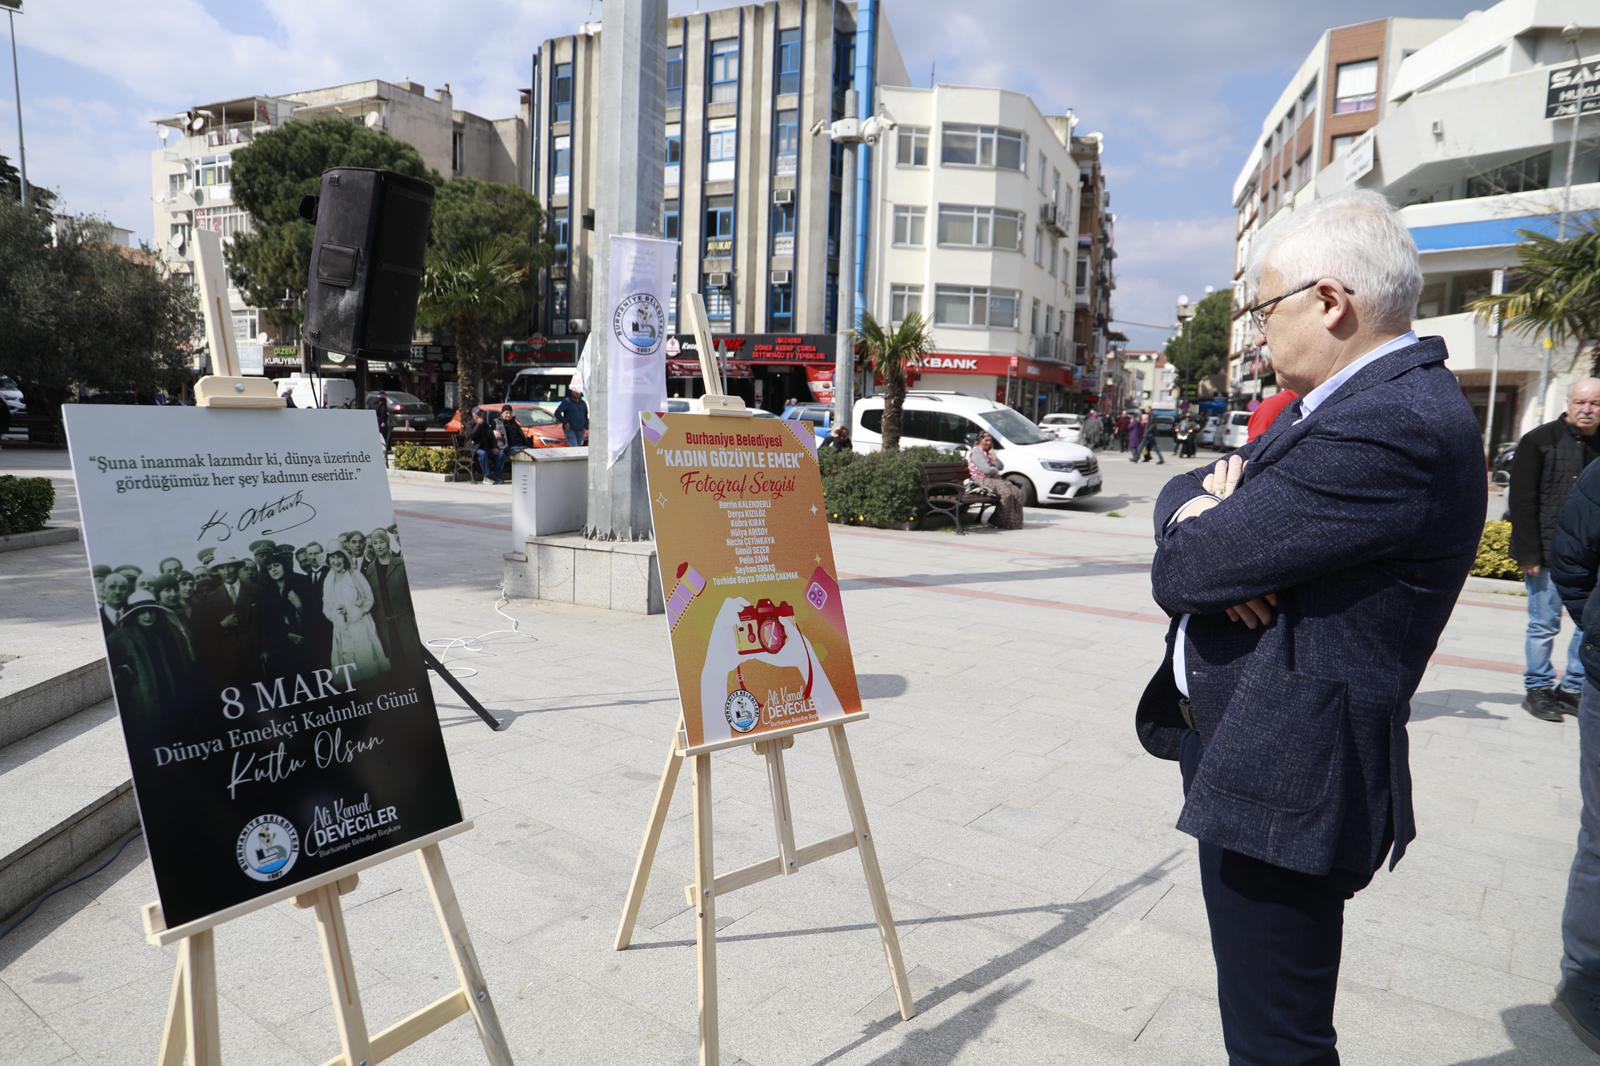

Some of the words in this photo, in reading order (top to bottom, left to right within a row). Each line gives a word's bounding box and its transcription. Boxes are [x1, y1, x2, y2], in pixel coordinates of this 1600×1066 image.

[686, 432, 734, 447] Burhaniye
[736, 433, 783, 448] Belediyesi
[141, 453, 205, 469] inanmak
[208, 451, 265, 467] lazımdır
[267, 452, 282, 467] ki,
[285, 451, 321, 468] dünya
[323, 450, 371, 464] üzerinde
[710, 448, 766, 468] GÖZÜYLE
[116, 472, 210, 493] gördüğümüz
[212, 470, 236, 487] her
[238, 472, 259, 489] şey
[262, 469, 308, 485] kadının
[750, 471, 797, 500] Sergisi
[220, 686, 245, 720] 8
[251, 662, 358, 713] MART
[153, 734, 224, 767] Dünya
[227, 716, 298, 749] Emekçi
[301, 699, 374, 731] Kadınlar
[376, 688, 419, 711] Günü
[227, 742, 305, 800] Kutlu
[314, 727, 385, 768] Olsun
